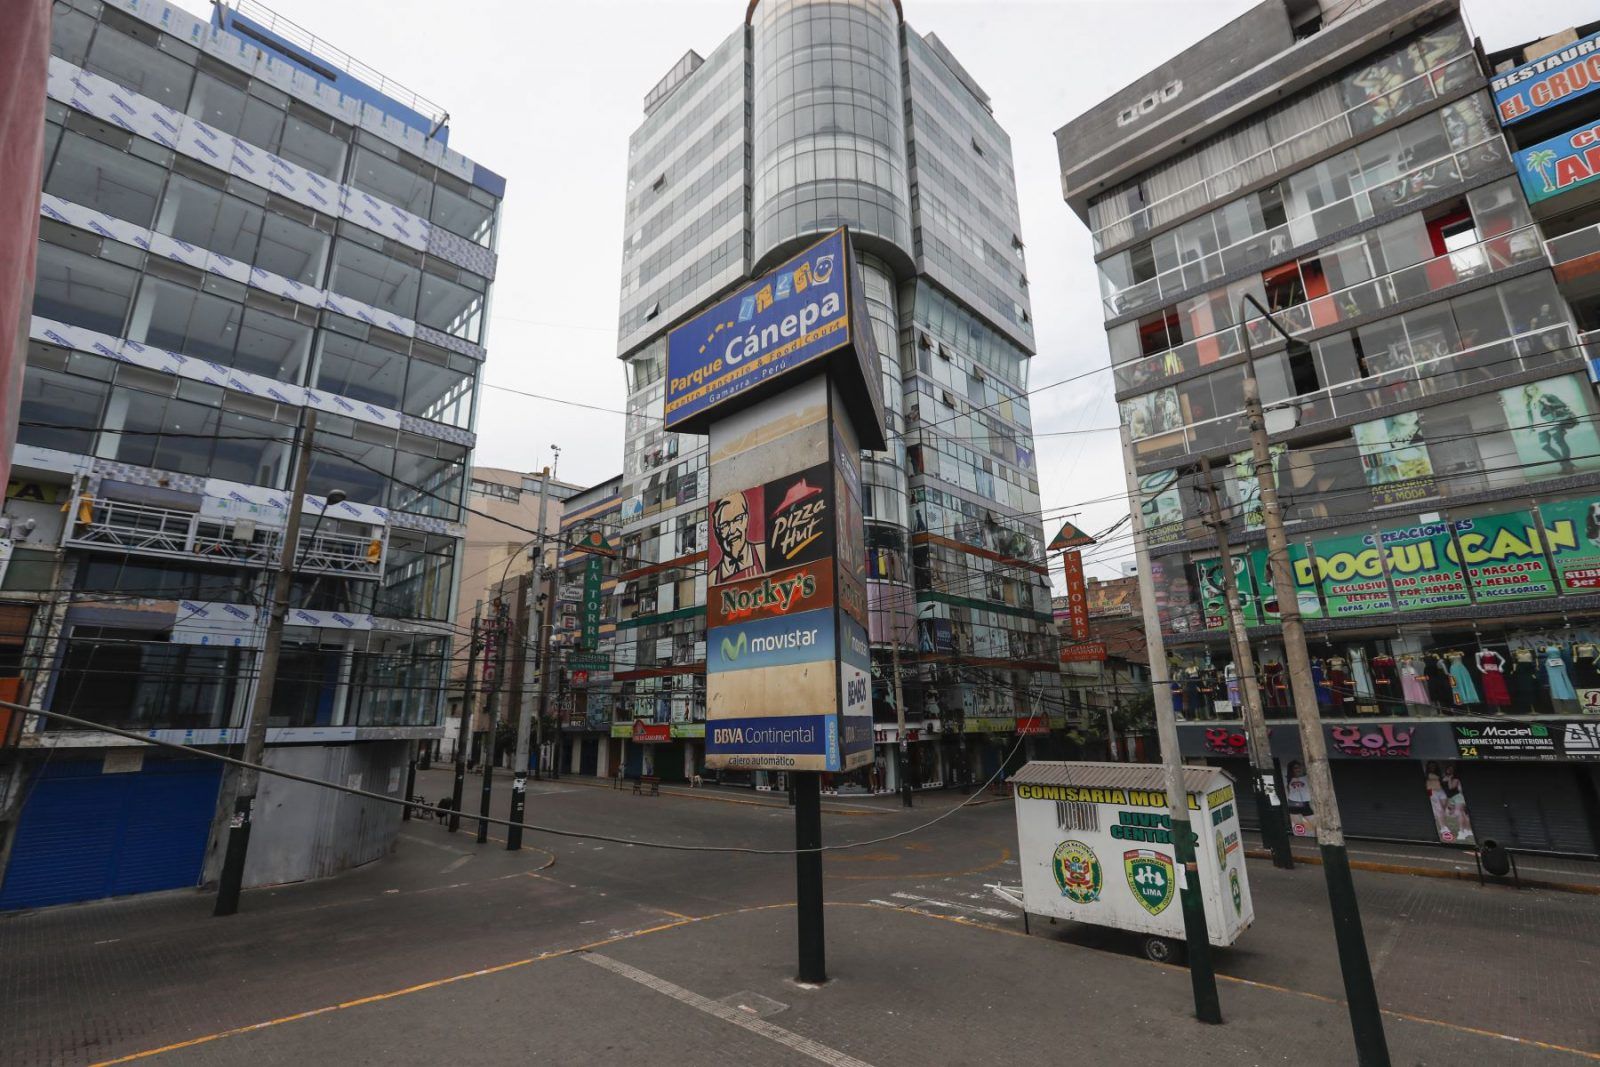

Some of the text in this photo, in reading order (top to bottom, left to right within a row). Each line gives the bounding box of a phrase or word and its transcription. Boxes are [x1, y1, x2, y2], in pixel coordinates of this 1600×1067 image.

[1499, 93, 1530, 122] EL
[670, 292, 840, 395] Parque Cánepa
[668, 321, 840, 412] Centro Bancario & Food Court
[709, 379, 750, 403] Gamarra
[762, 360, 787, 378] Perú
[1395, 488, 1427, 501] MODA
[772, 500, 827, 548] Pizza
[781, 517, 823, 555] Hut
[1362, 518, 1474, 546] CREACIONES
[1293, 520, 1580, 587] DOGUI CAN
[1420, 572, 1451, 584] PARA
[1455, 570, 1478, 581] SU
[1483, 561, 1543, 577] MASCOTA
[720, 573, 817, 615] Norky's
[1067, 553, 1085, 639] LA TORRE
[1347, 574, 1530, 603] VENTAS POR MAYOR Y MENOR
[1486, 584, 1548, 597] ACCESORIOS
[587, 560, 599, 646] LA TORRE
[751, 629, 818, 653] movistar
[714, 725, 815, 745] BBVA Continental
[1456, 726, 1532, 738] Vip Model
[728, 754, 795, 766] cajero automático
[1460, 747, 1478, 756] 24
[1017, 783, 1127, 806] COMISARIA
[1127, 789, 1201, 810] MOL
[1142, 887, 1162, 897] LIMA
